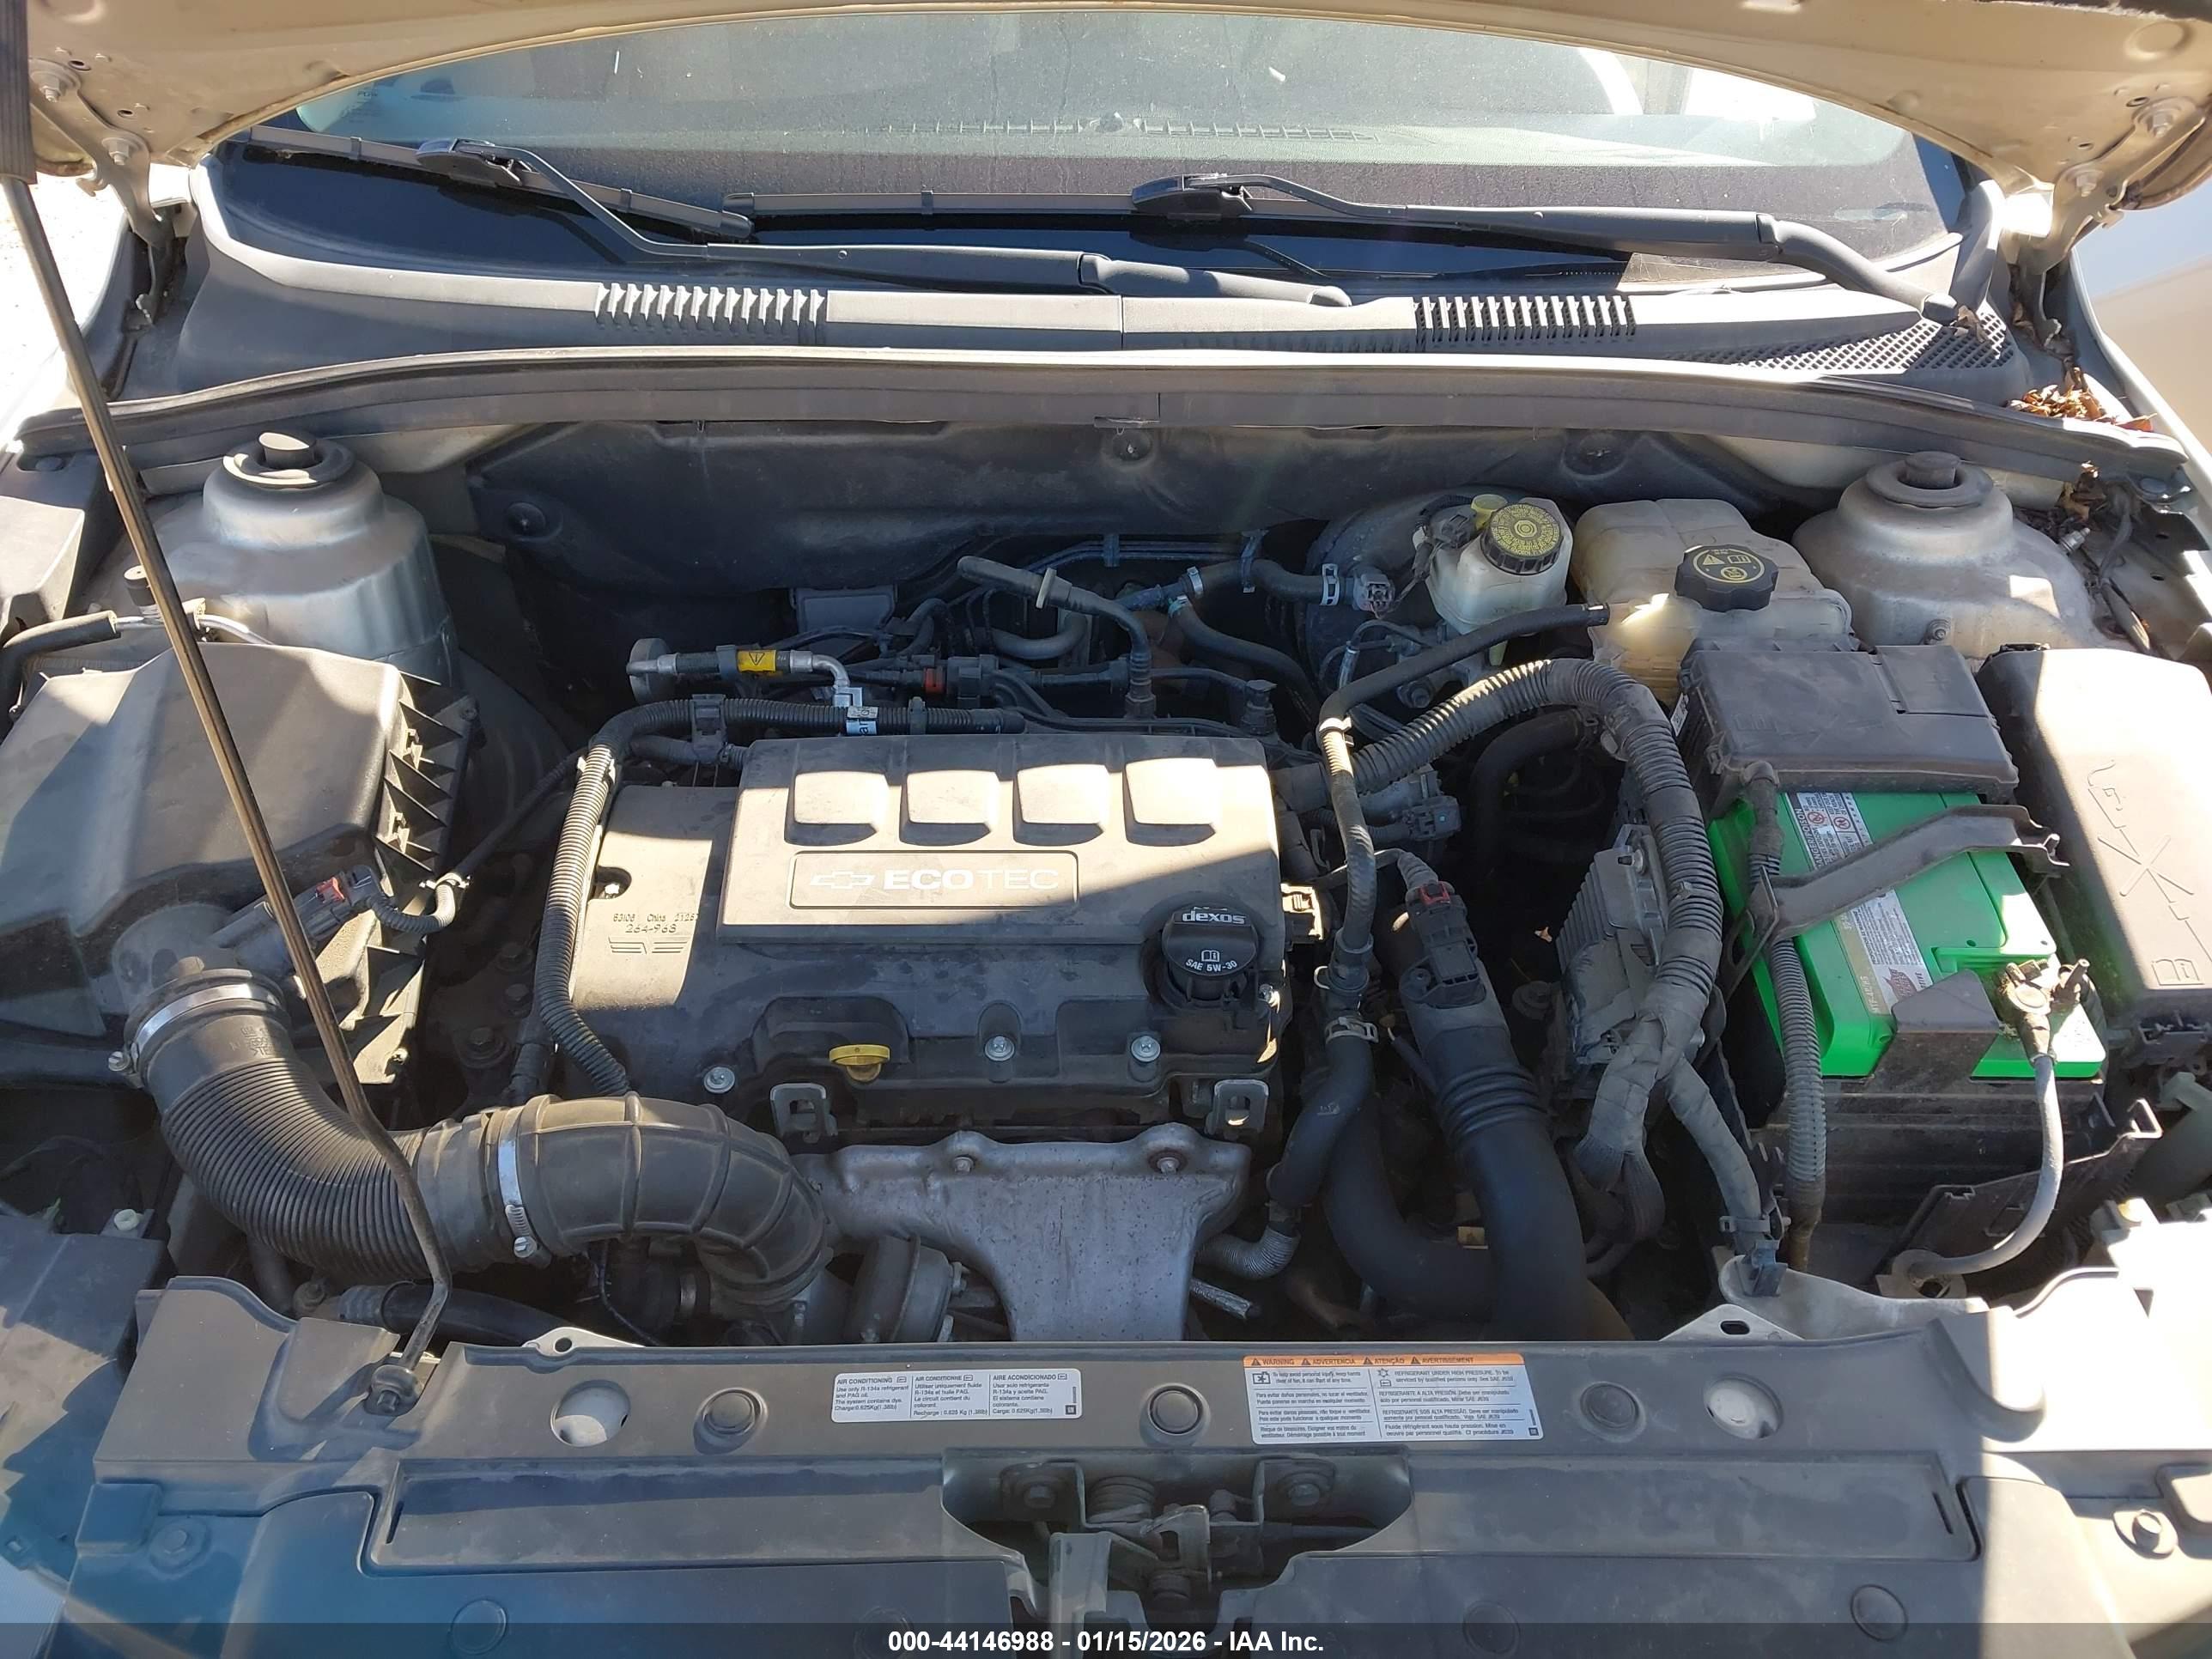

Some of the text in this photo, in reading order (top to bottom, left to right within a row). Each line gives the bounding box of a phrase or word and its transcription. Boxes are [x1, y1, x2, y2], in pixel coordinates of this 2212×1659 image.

[883, 869, 1059, 890] ECOTEC
[1182, 911, 1247, 924] dexos
[1186, 959, 1237, 972] SAE 5W-30
